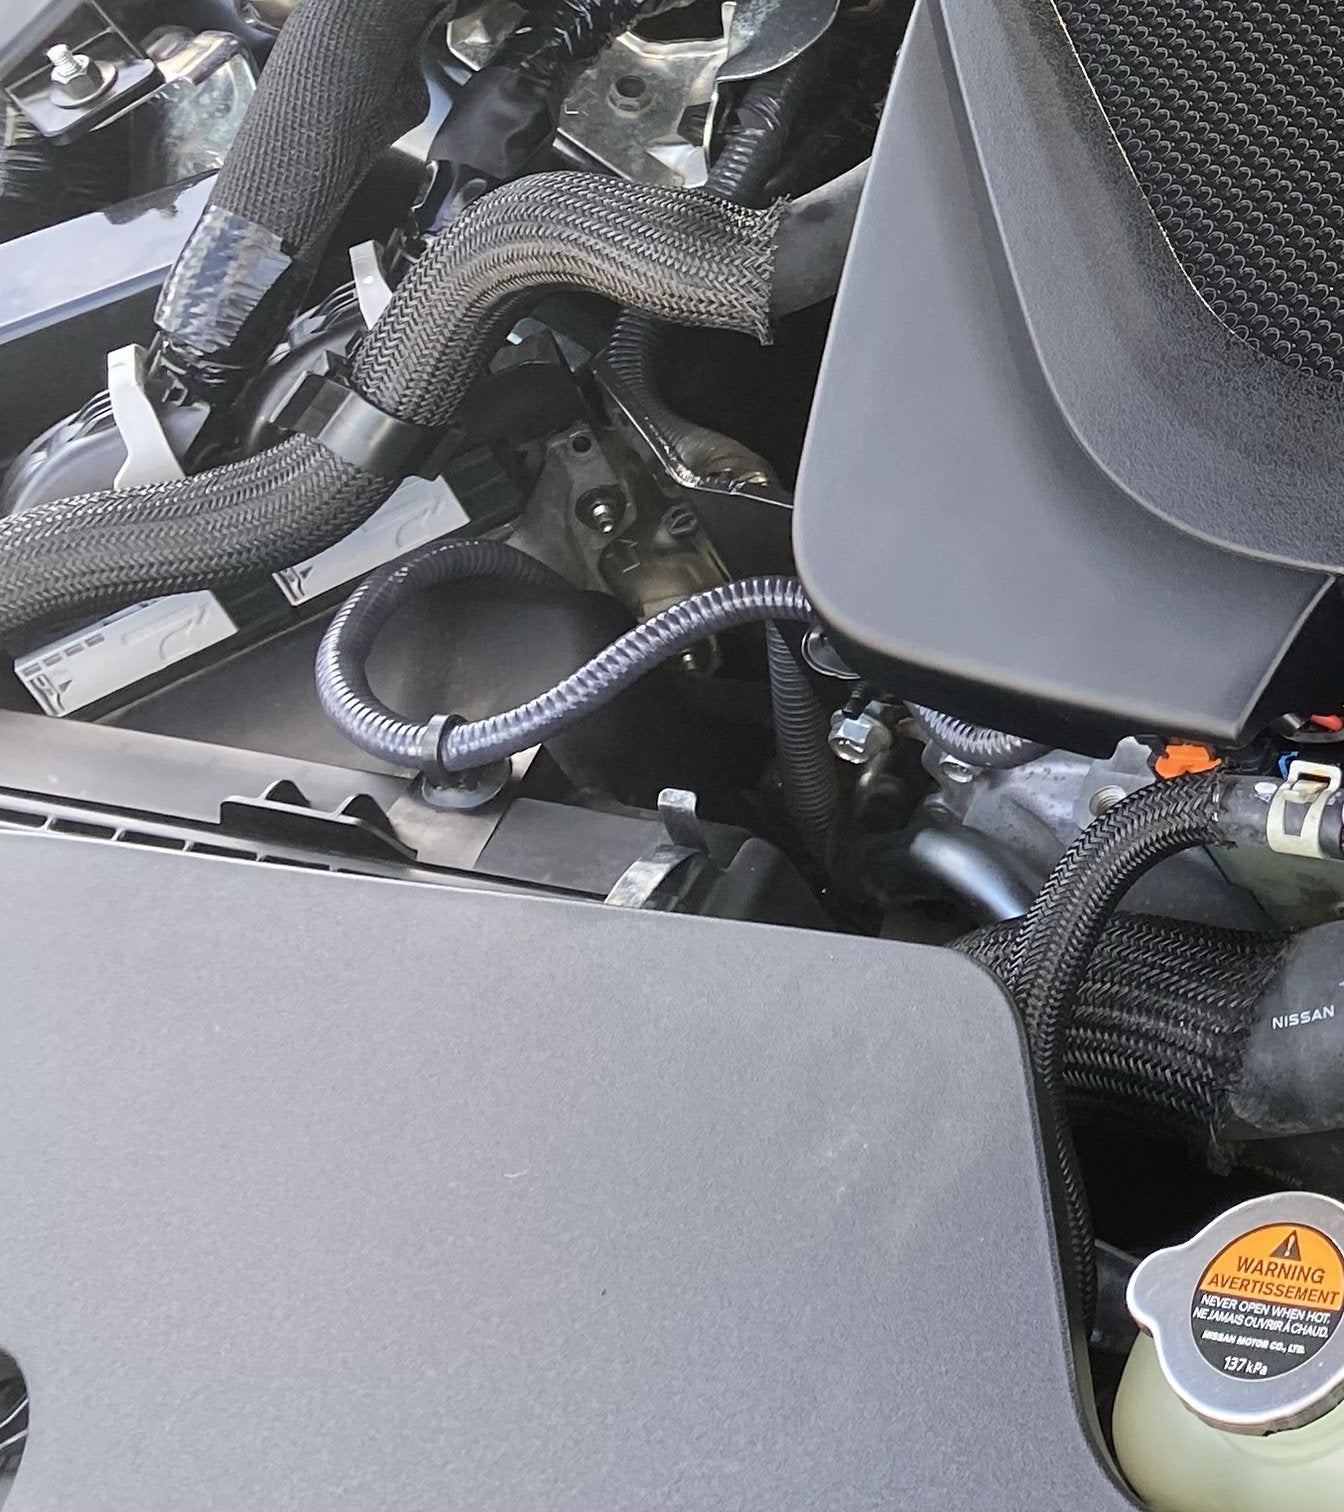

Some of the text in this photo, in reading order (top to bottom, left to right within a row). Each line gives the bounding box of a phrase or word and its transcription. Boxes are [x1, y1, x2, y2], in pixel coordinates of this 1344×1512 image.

[1272, 1004, 1335, 1030] NISSAN
[1236, 1255, 1326, 1285] WARNING
[1207, 1273, 1340, 1305] AVERTISSEMENT
[1192, 1306, 1208, 1319] NE
[1207, 1310, 1244, 1326] JAMAIS
[1244, 1315, 1283, 1331] OUVRIR
[1290, 1323, 1329, 1339] CHAUD.
[1201, 1294, 1331, 1325] NEVER OPEN WHEN HOT.
[1202, 1329, 1236, 1345] NISSAN
[1236, 1336, 1268, 1350] MOTOR
[1224, 1356, 1268, 1376] 137 kPa
